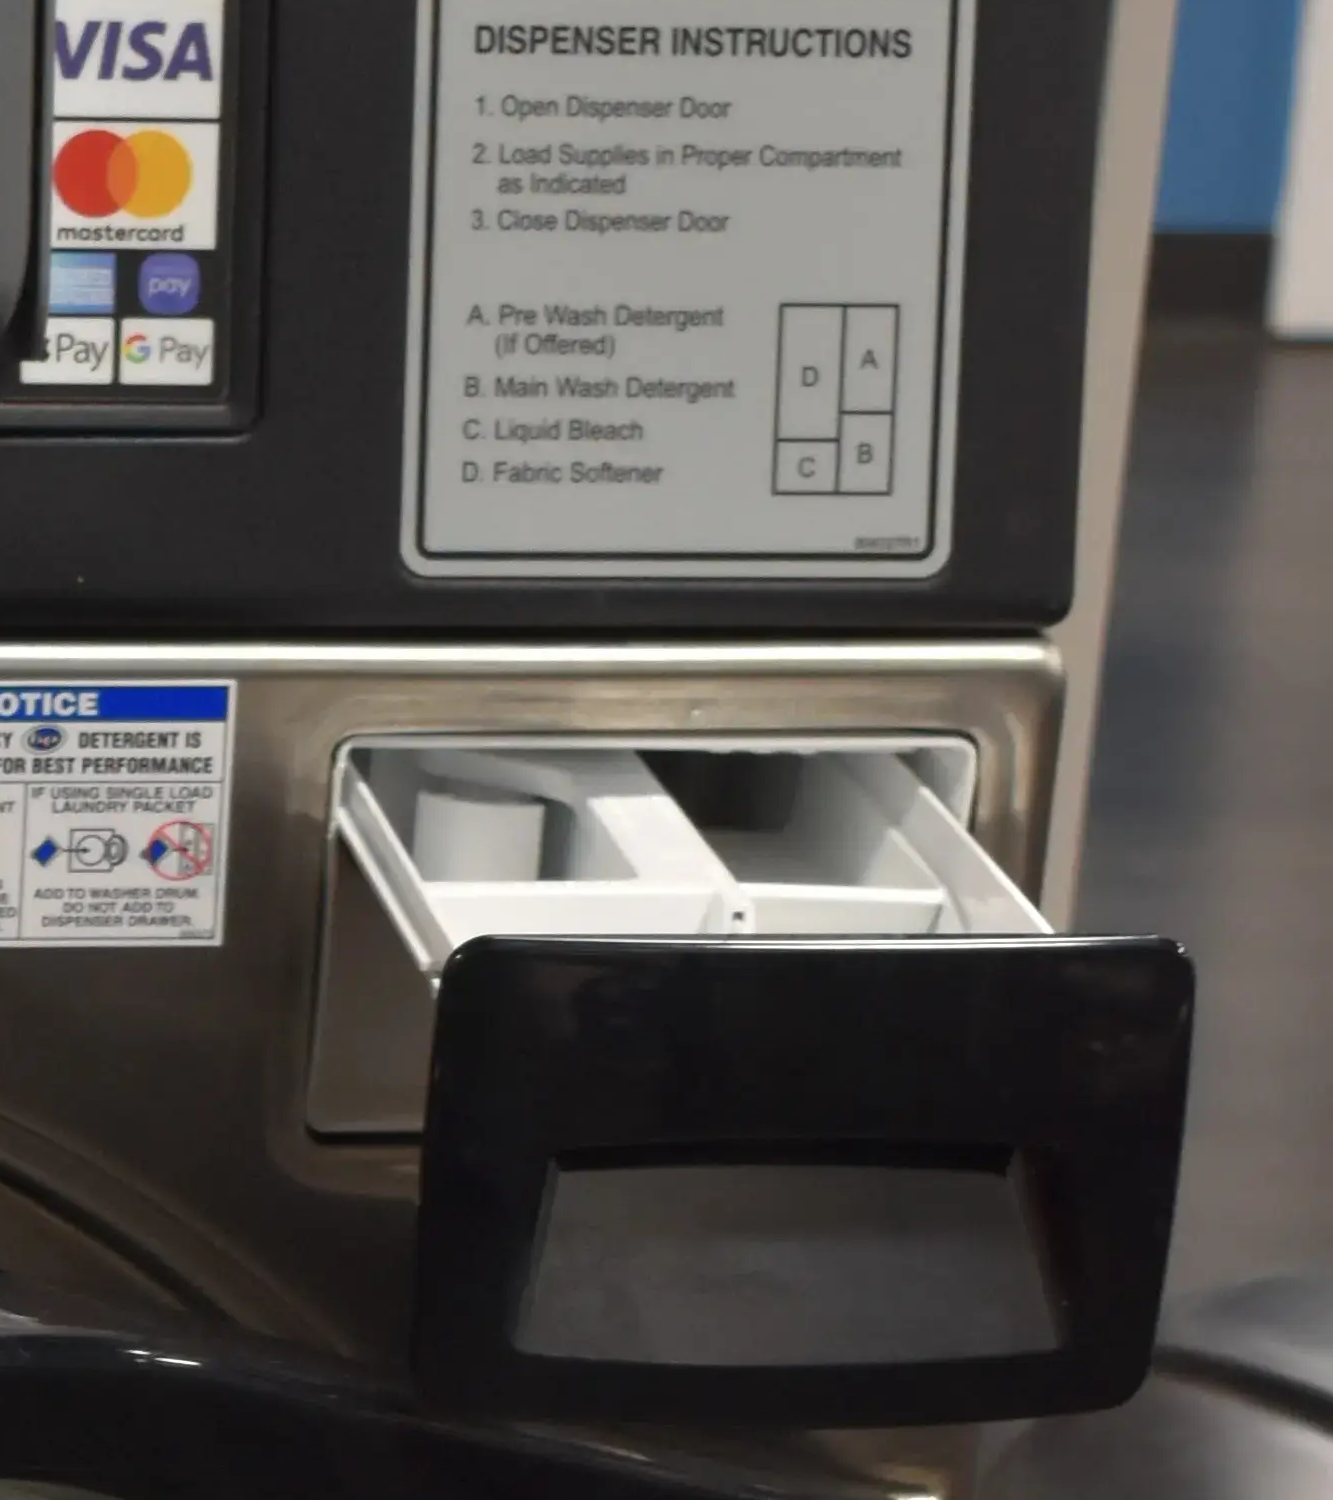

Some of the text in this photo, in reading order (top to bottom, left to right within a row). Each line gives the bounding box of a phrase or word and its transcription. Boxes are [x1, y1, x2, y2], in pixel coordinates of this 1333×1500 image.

[55, 22, 214, 81] VISA
[475, 25, 912, 58] DISPENSER INSTRUCTIONS
[475, 95, 732, 121] 1. Open Dispenser Door
[472, 144, 902, 173] 2. Load Supplies in Proper Compartment
[497, 173, 626, 195] as Indicated
[472, 209, 730, 234] 3. Close Dispenser Door
[55, 226, 186, 246] mastercard
[148, 277, 192, 297] pay
[467, 304, 724, 331] A. Pre Wash Detergent
[56, 333, 108, 372] Pay
[159, 337, 209, 370] Pay
[495, 332, 615, 359] (If Offered)
[861, 349, 878, 369] A
[801, 366, 819, 387] D
[464, 376, 735, 404] B. Main Wash Detergent
[462, 418, 643, 445] C. Liquid Bleach
[857, 442, 873, 464] B
[462, 461, 664, 483] D. Fabric Softener
[798, 456, 816, 478] C
[79, 732, 180, 749] DETERGENT
[185, 731, 201, 749] IS
[32, 755, 76, 774] BEST
[82, 757, 212, 774] PERFORMANCE
[29, 785, 212, 802] IF USING SINGLE LOAD
[52, 799, 195, 813] LAUNDRY PACKET
